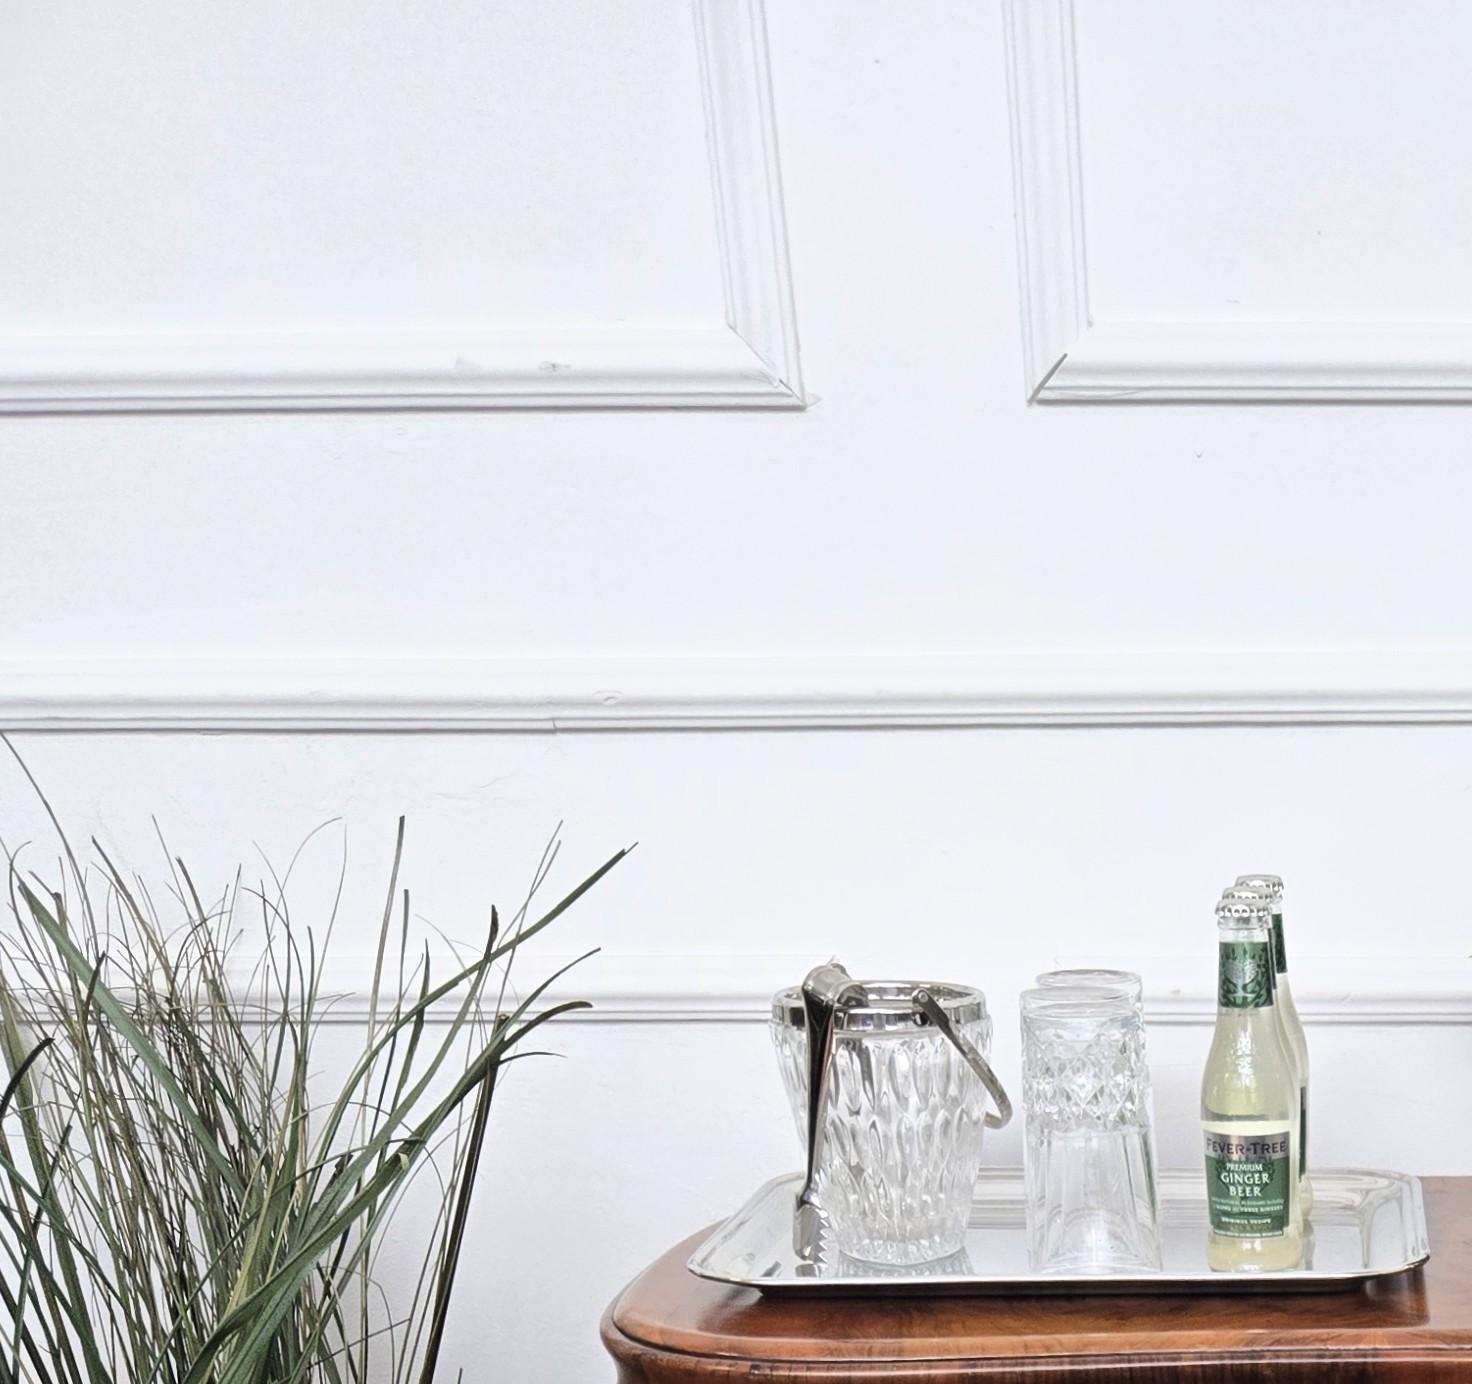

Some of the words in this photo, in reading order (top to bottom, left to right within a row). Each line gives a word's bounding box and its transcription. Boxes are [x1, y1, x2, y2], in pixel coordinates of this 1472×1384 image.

[1206, 1138, 1287, 1155] FEVER-TREE
[1226, 1162, 1263, 1171] PREMIUM
[1221, 1172, 1270, 1184] GINGER
[1229, 1185, 1262, 1197] BEER
